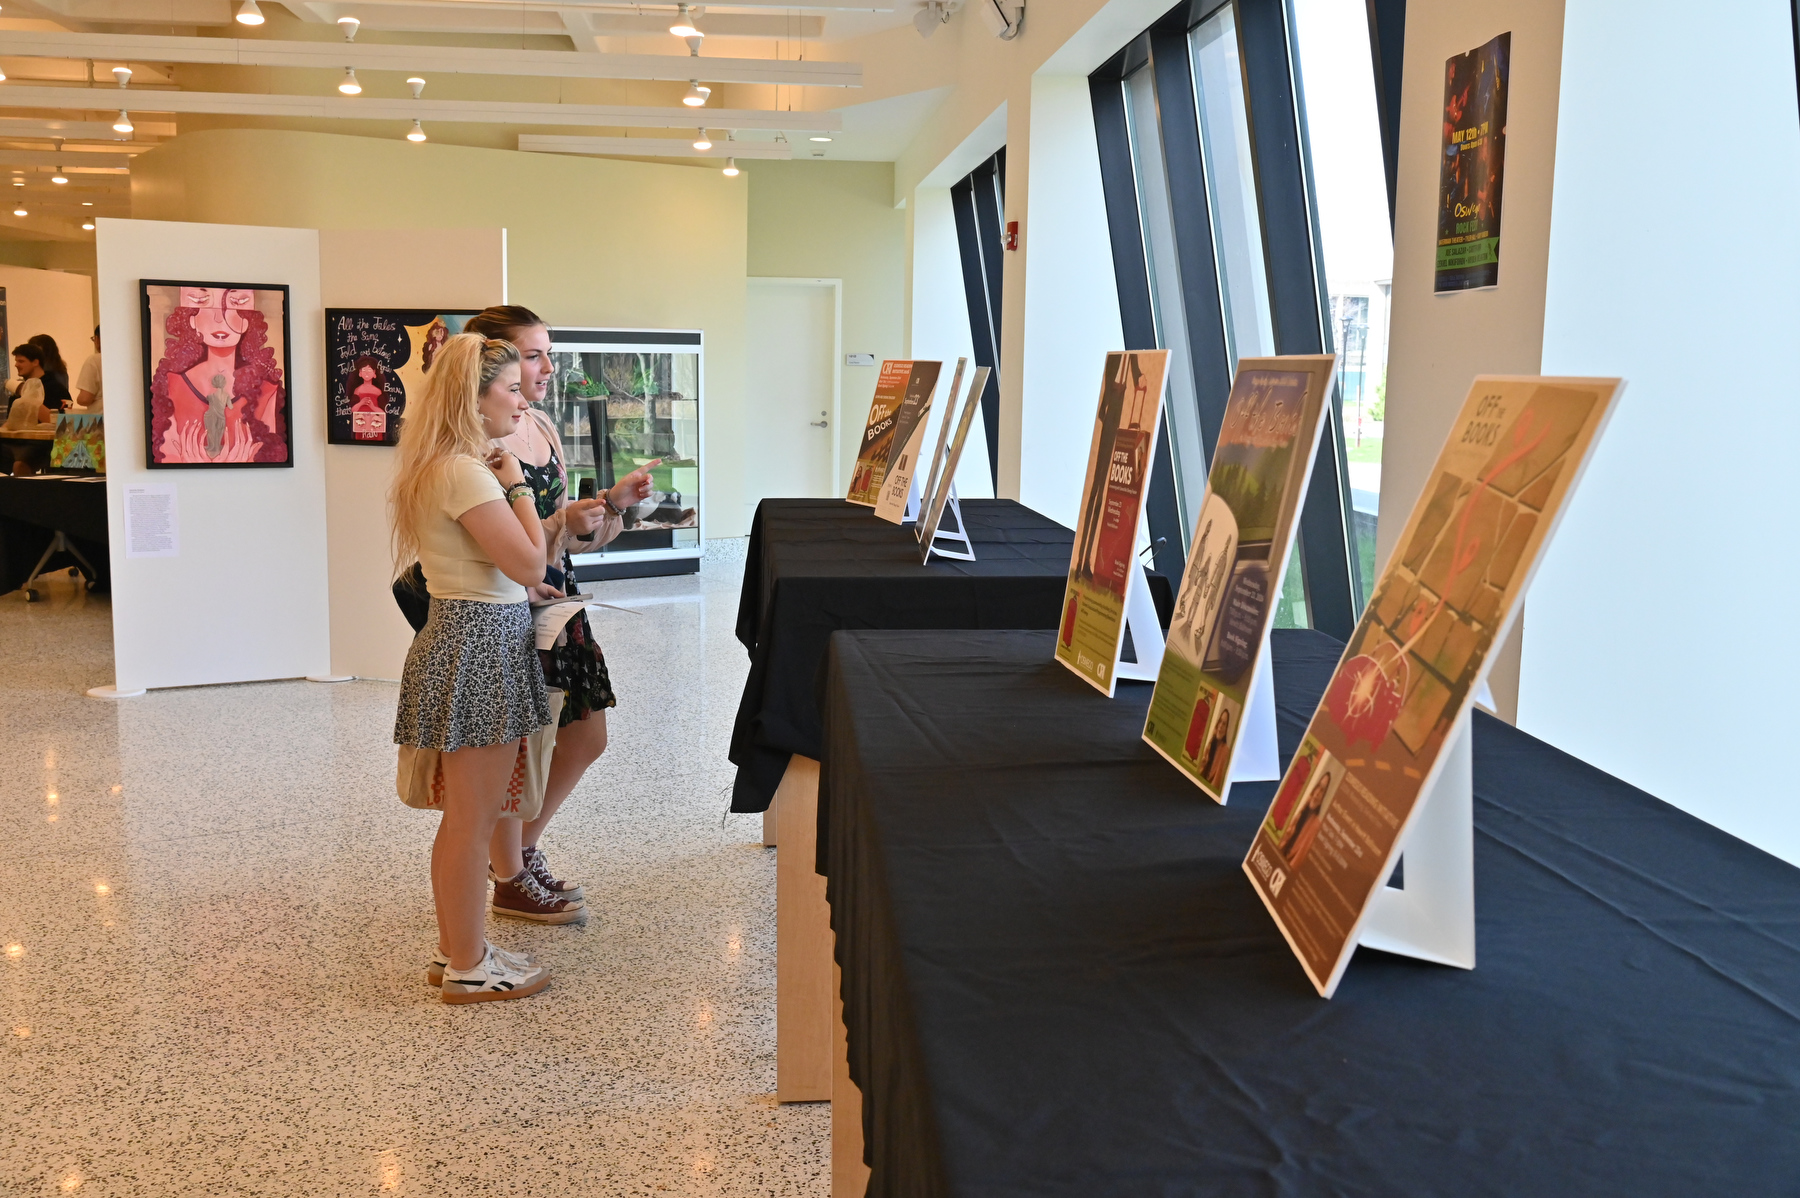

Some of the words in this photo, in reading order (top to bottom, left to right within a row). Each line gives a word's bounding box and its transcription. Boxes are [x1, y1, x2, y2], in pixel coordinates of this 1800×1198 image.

[338, 316, 354, 331] All
[356, 318, 370, 331] the
[372, 316, 396, 331] Tales
[346, 332, 358, 343] the
[361, 331, 379, 342] Same
[336, 342, 357, 359] Told
[337, 359, 356, 375] Told
[337, 382, 345, 395] A
[385, 404, 400, 415] Cold
[1476, 395, 1502, 418] OFF
[867, 418, 892, 440] BOOKS
[1461, 421, 1501, 447] BOOKS
[1110, 463, 1133, 485] BOOKS
[427, 795, 444, 806] LO
[501, 798, 521, 813] UR
